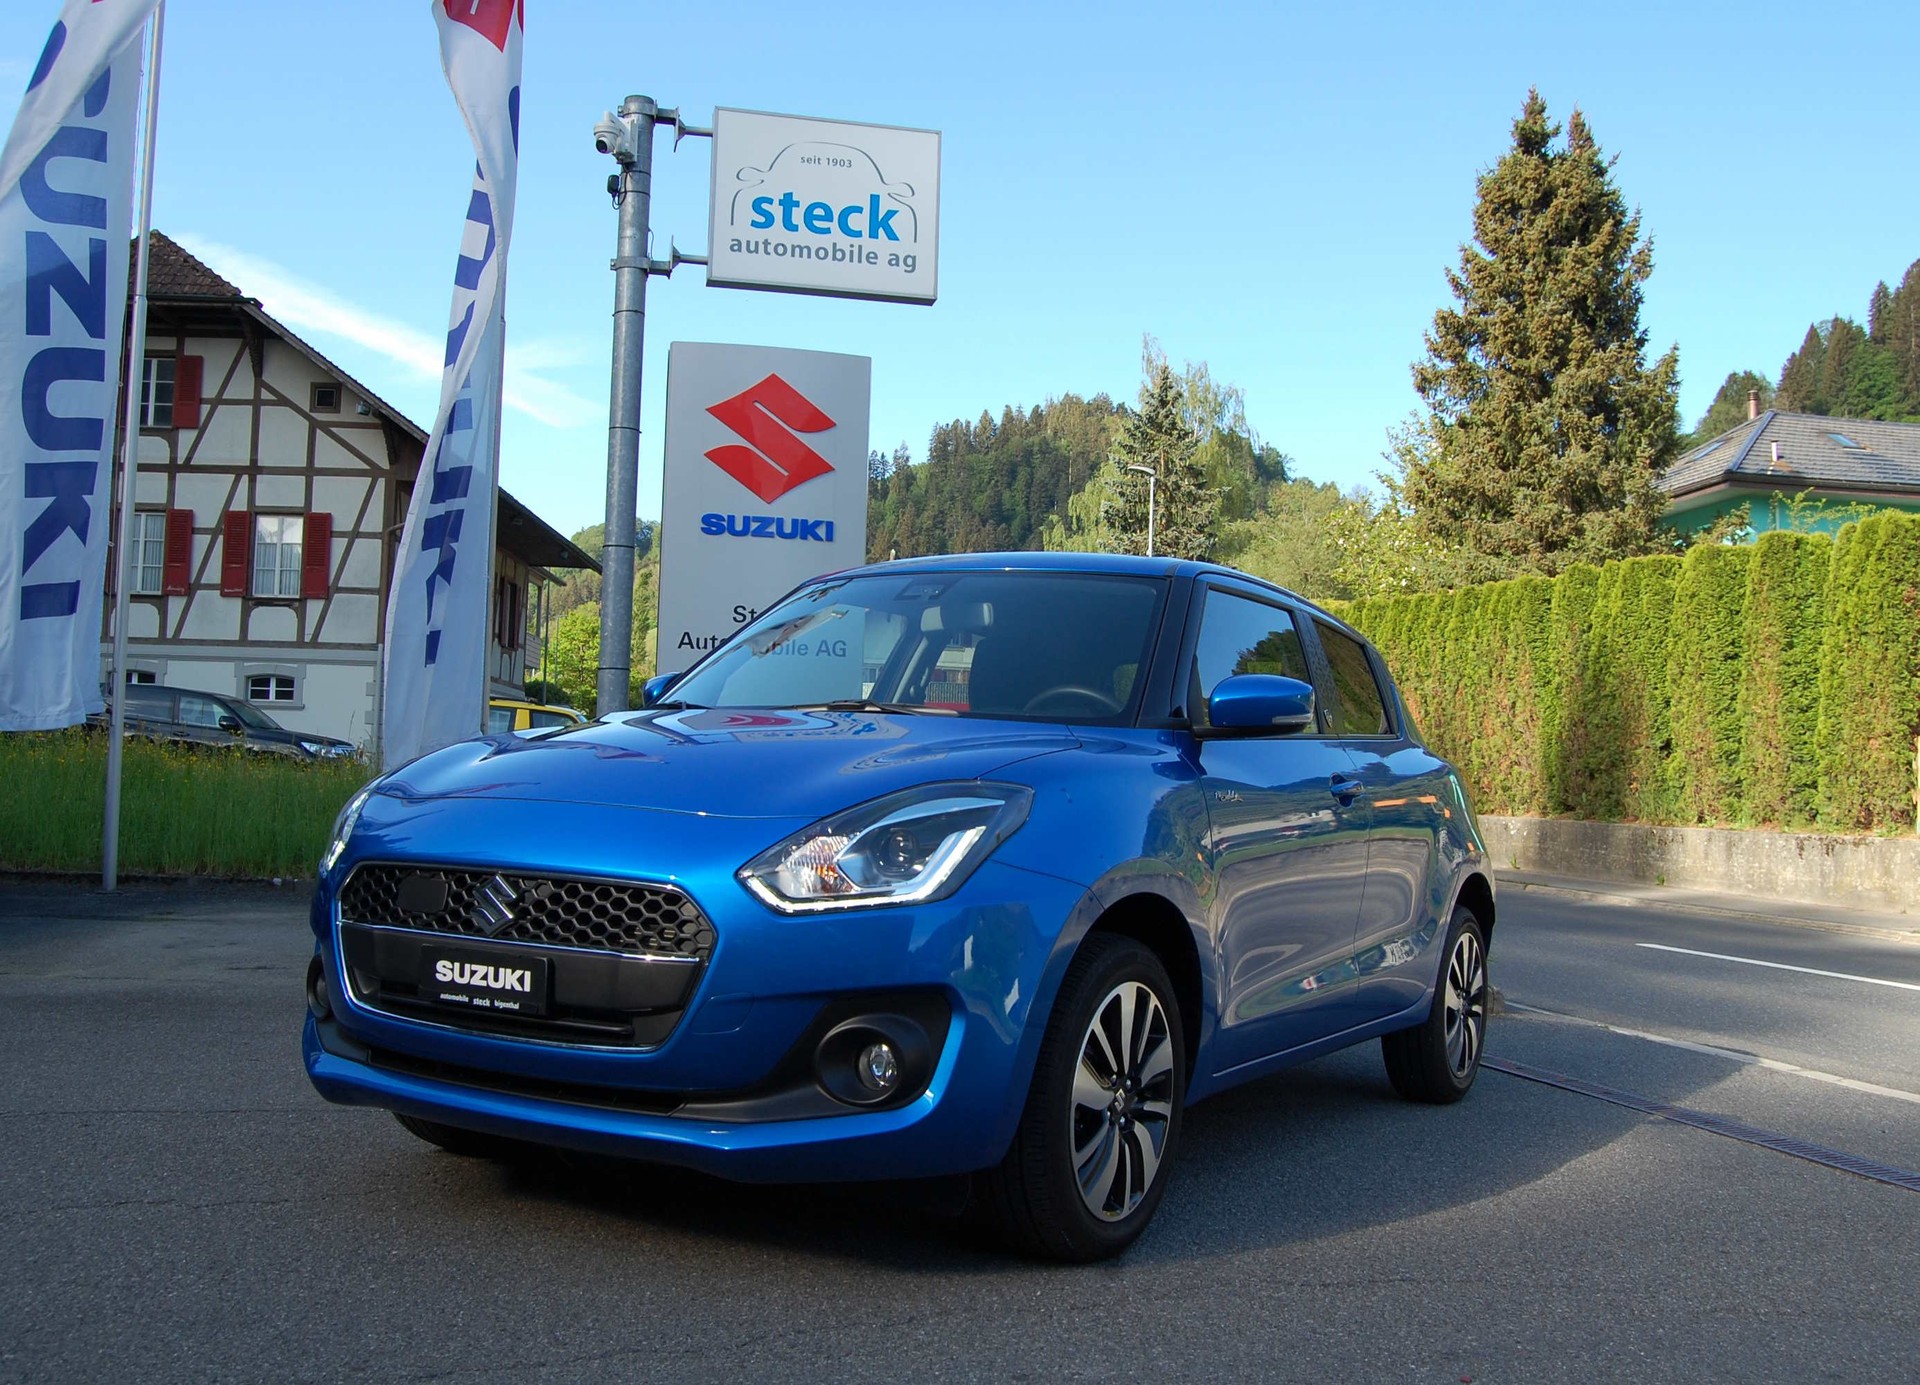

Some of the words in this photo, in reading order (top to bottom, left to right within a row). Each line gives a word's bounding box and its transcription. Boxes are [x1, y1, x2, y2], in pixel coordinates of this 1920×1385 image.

[800, 155, 822, 165] seit
[826, 157, 853, 168] 1903
[750, 192, 900, 241] steck
[729, 237, 878, 266] automobile
[887, 253, 917, 274] ag
[700, 512, 834, 542] SUZUKI
[815, 640, 847, 659] AG
[435, 959, 532, 992] SUZUKI
